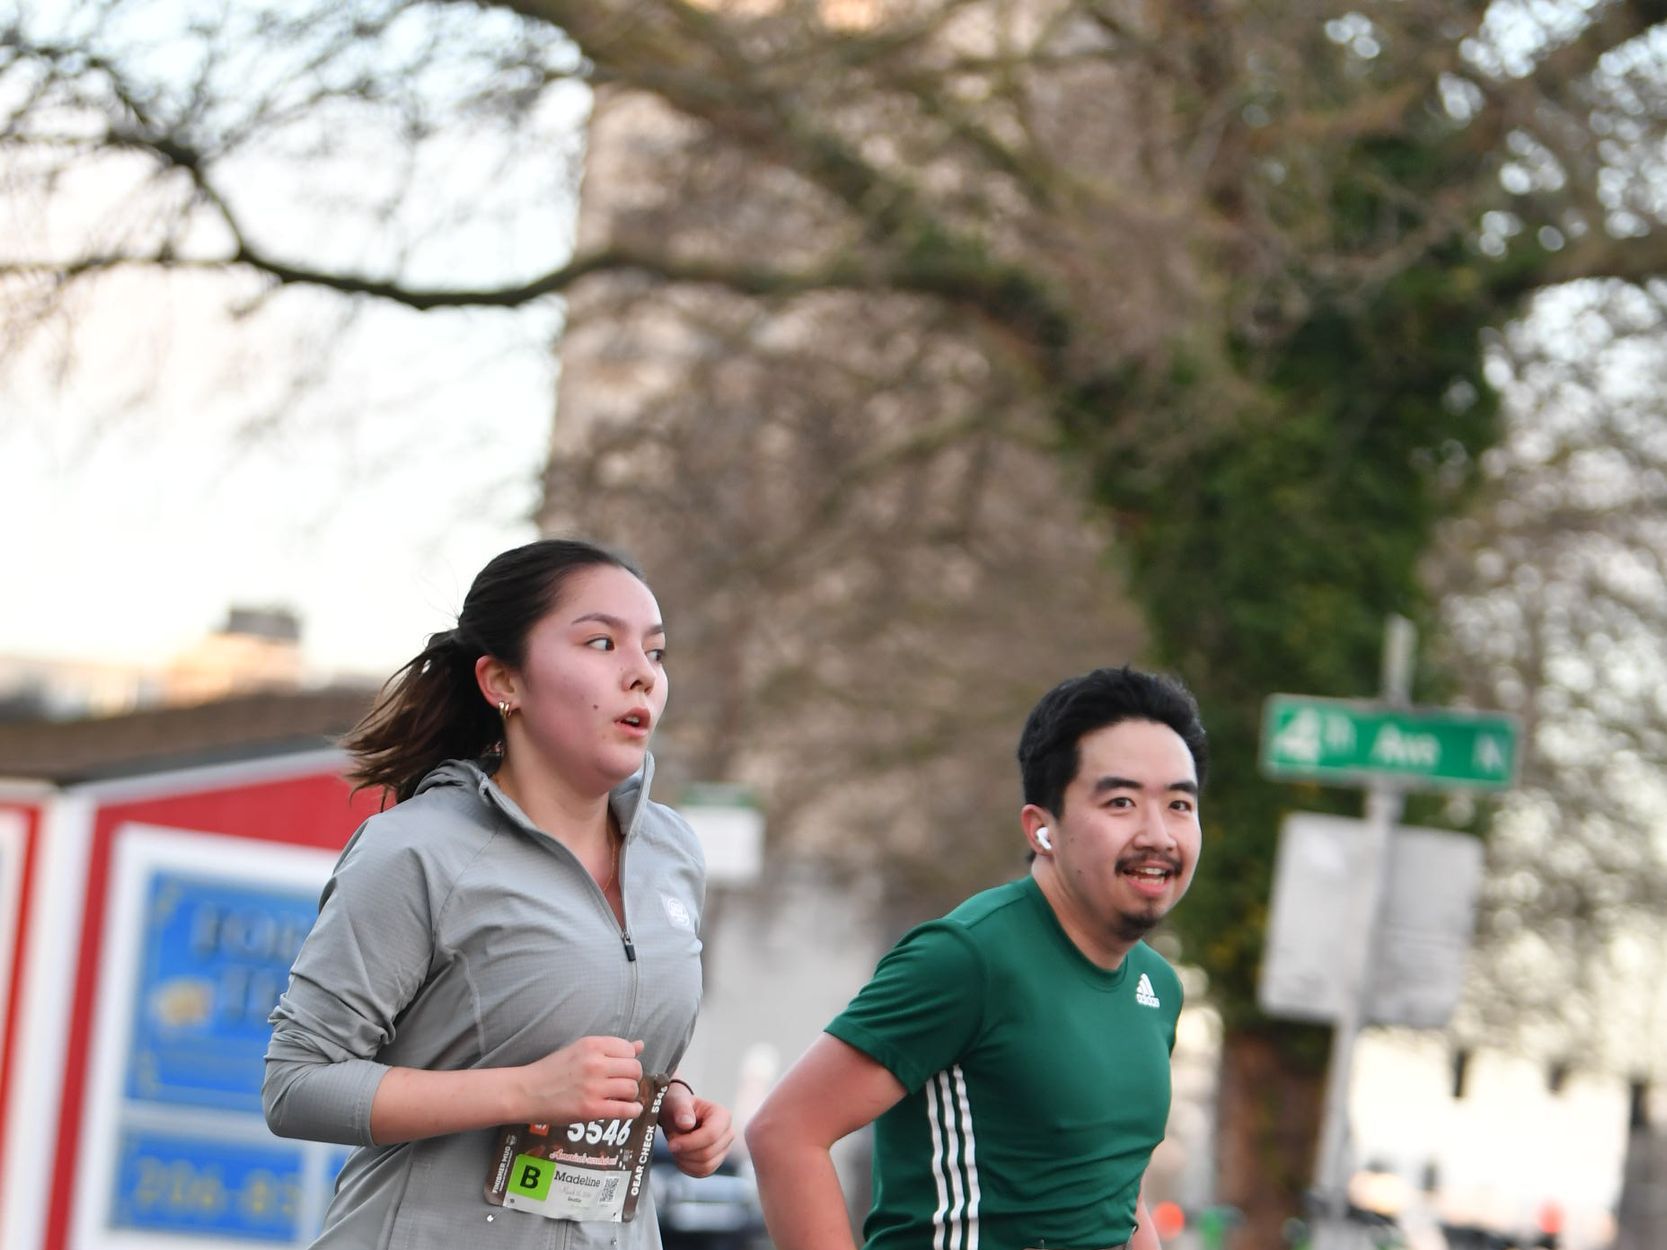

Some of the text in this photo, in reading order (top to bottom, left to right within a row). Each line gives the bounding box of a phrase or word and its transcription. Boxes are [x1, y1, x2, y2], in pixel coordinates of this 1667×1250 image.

[567, 1119, 632, 1146] 5546
[631, 1165, 644, 1197] GEAR
[639, 1125, 655, 1165] CHECK
[520, 1165, 542, 1190] B
[553, 1170, 601, 1188] Madeline
